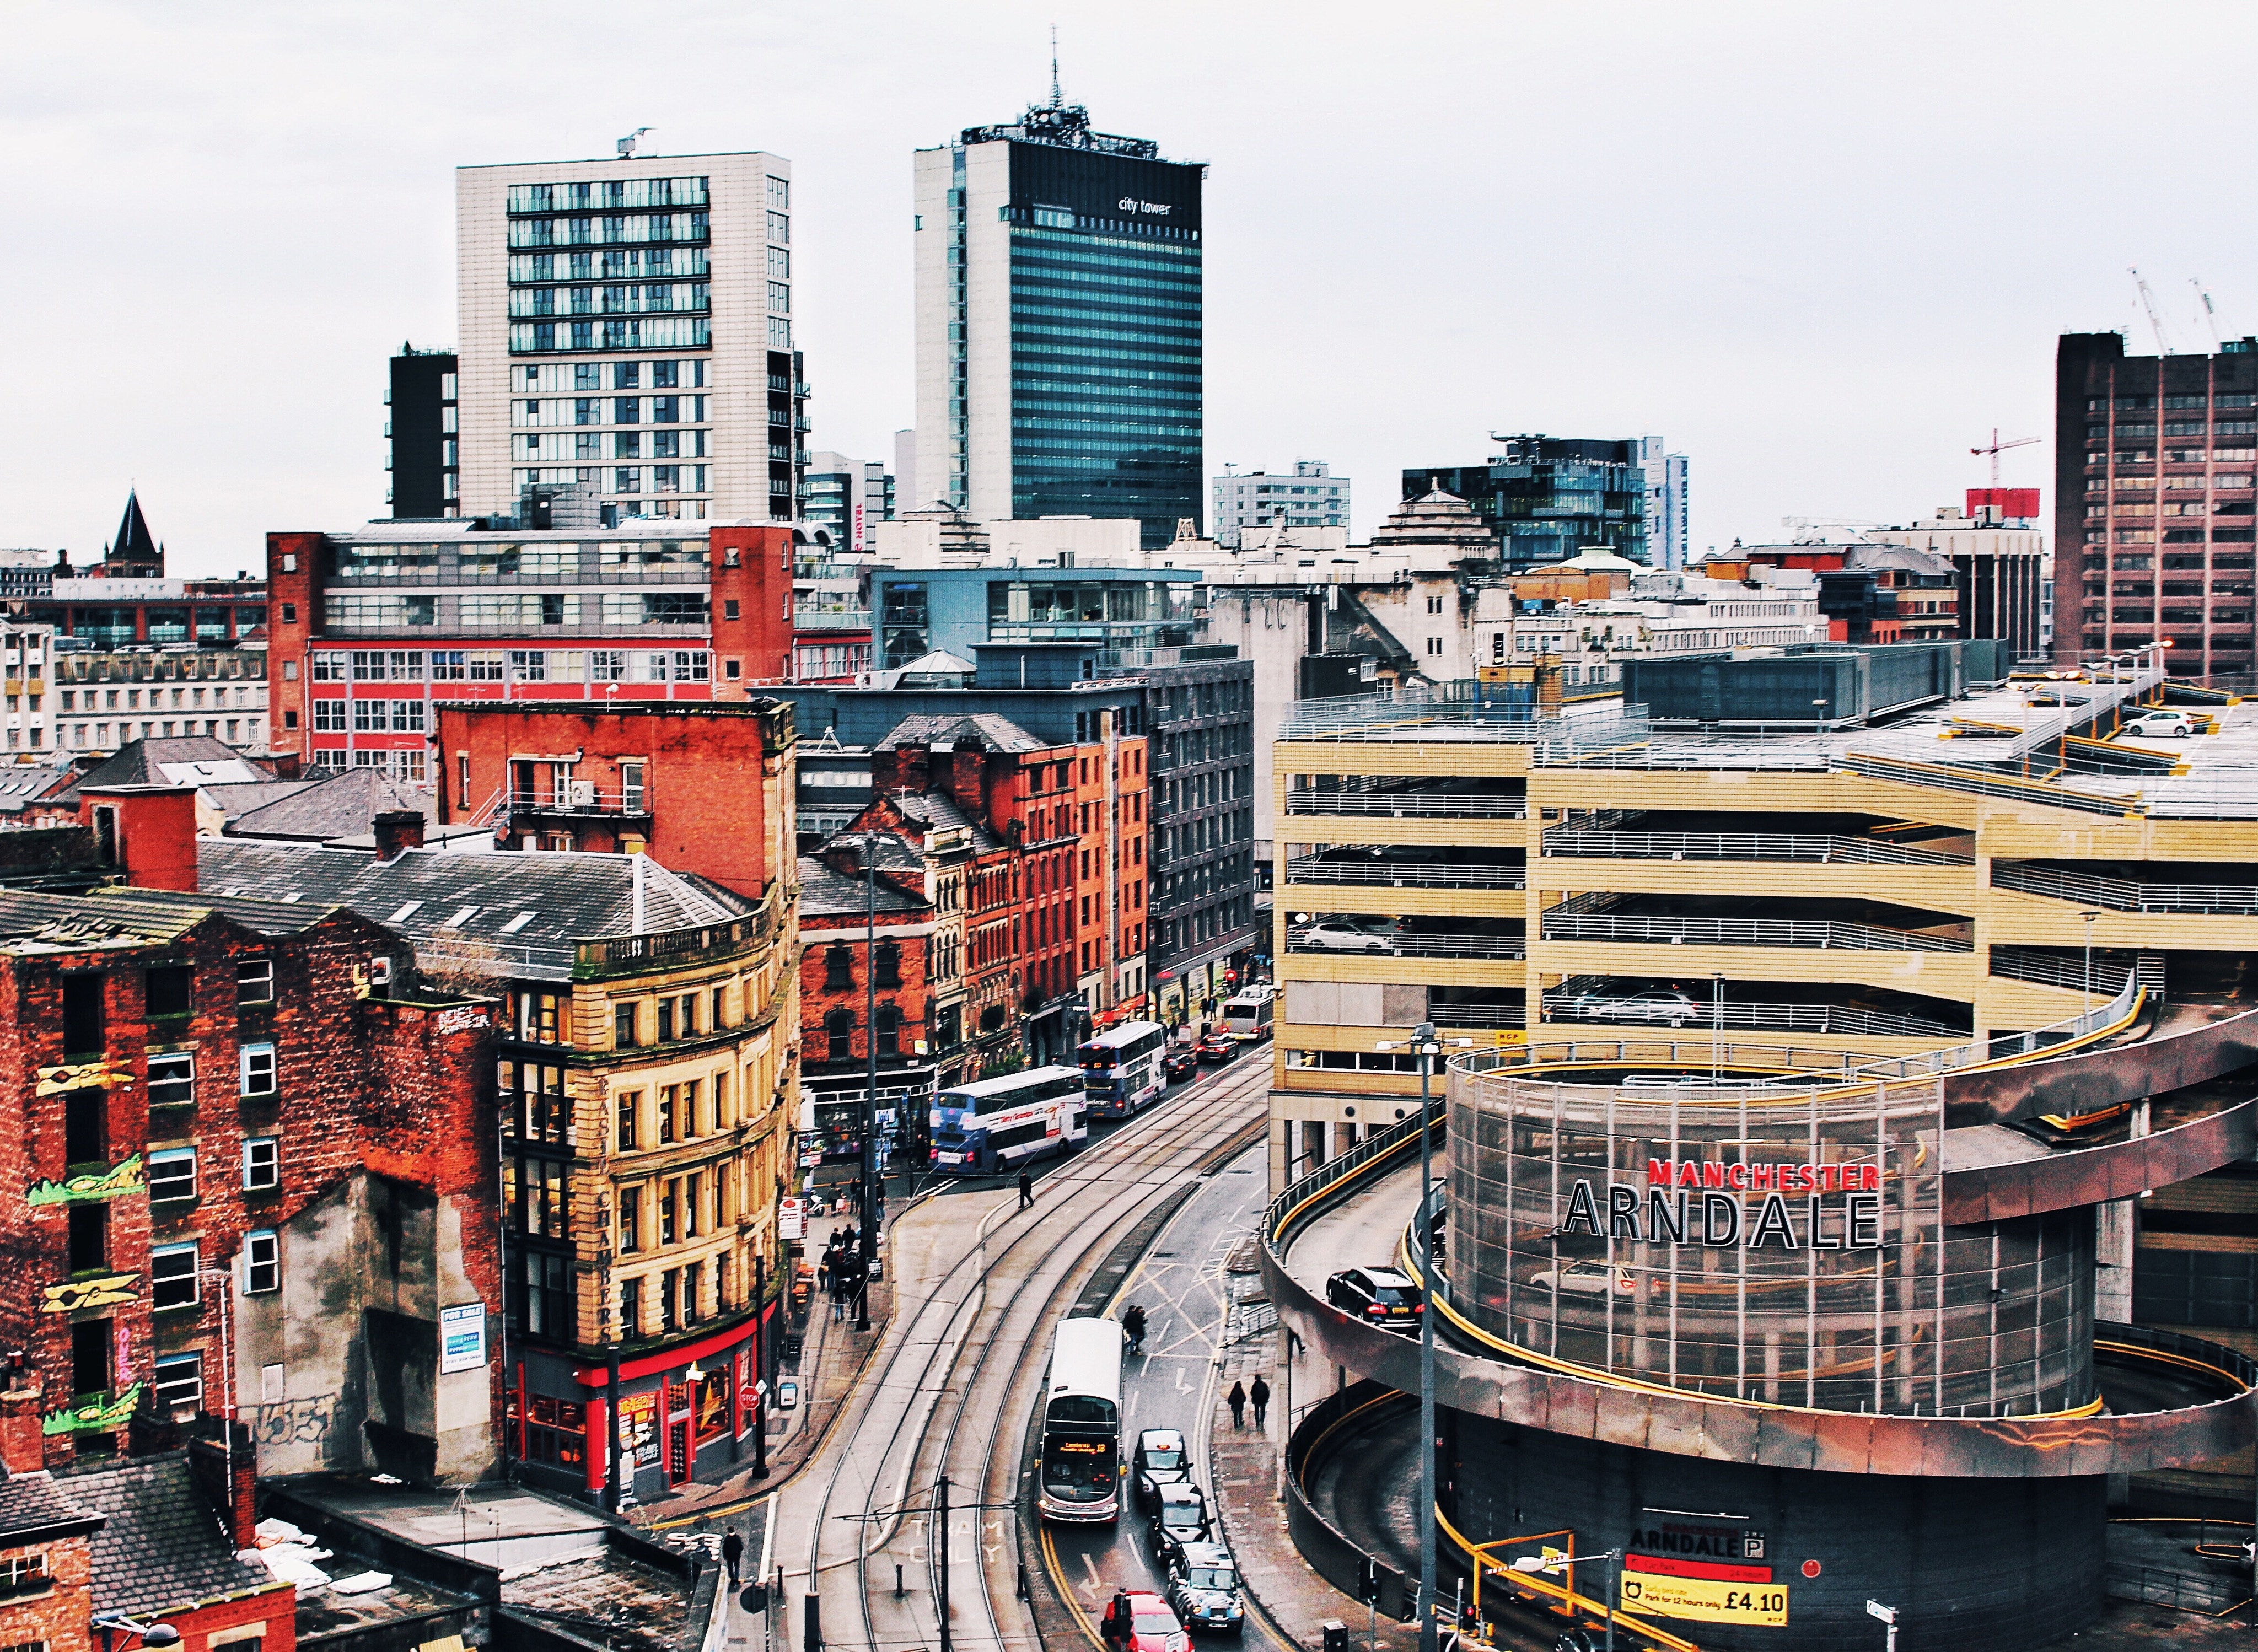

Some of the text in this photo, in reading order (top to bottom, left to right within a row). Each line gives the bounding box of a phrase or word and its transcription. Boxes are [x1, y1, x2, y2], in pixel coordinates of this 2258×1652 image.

[1118, 196, 1173, 216] city tower
[1649, 1157, 1879, 1191] MANCHESTER
[1562, 1178, 1879, 1250] ARNDALE
[597, 1191, 611, 1343] CHAMBERS
[444, 1307, 481, 1321] FOR SALE
[741, 1393, 758, 1402] STOP
[1630, 1528, 1761, 1558] ARNDALE P
[1683, 1599, 1703, 1607] hours
[1705, 1601, 1721, 1610] only
[1724, 1591, 1783, 1612] £4.10
